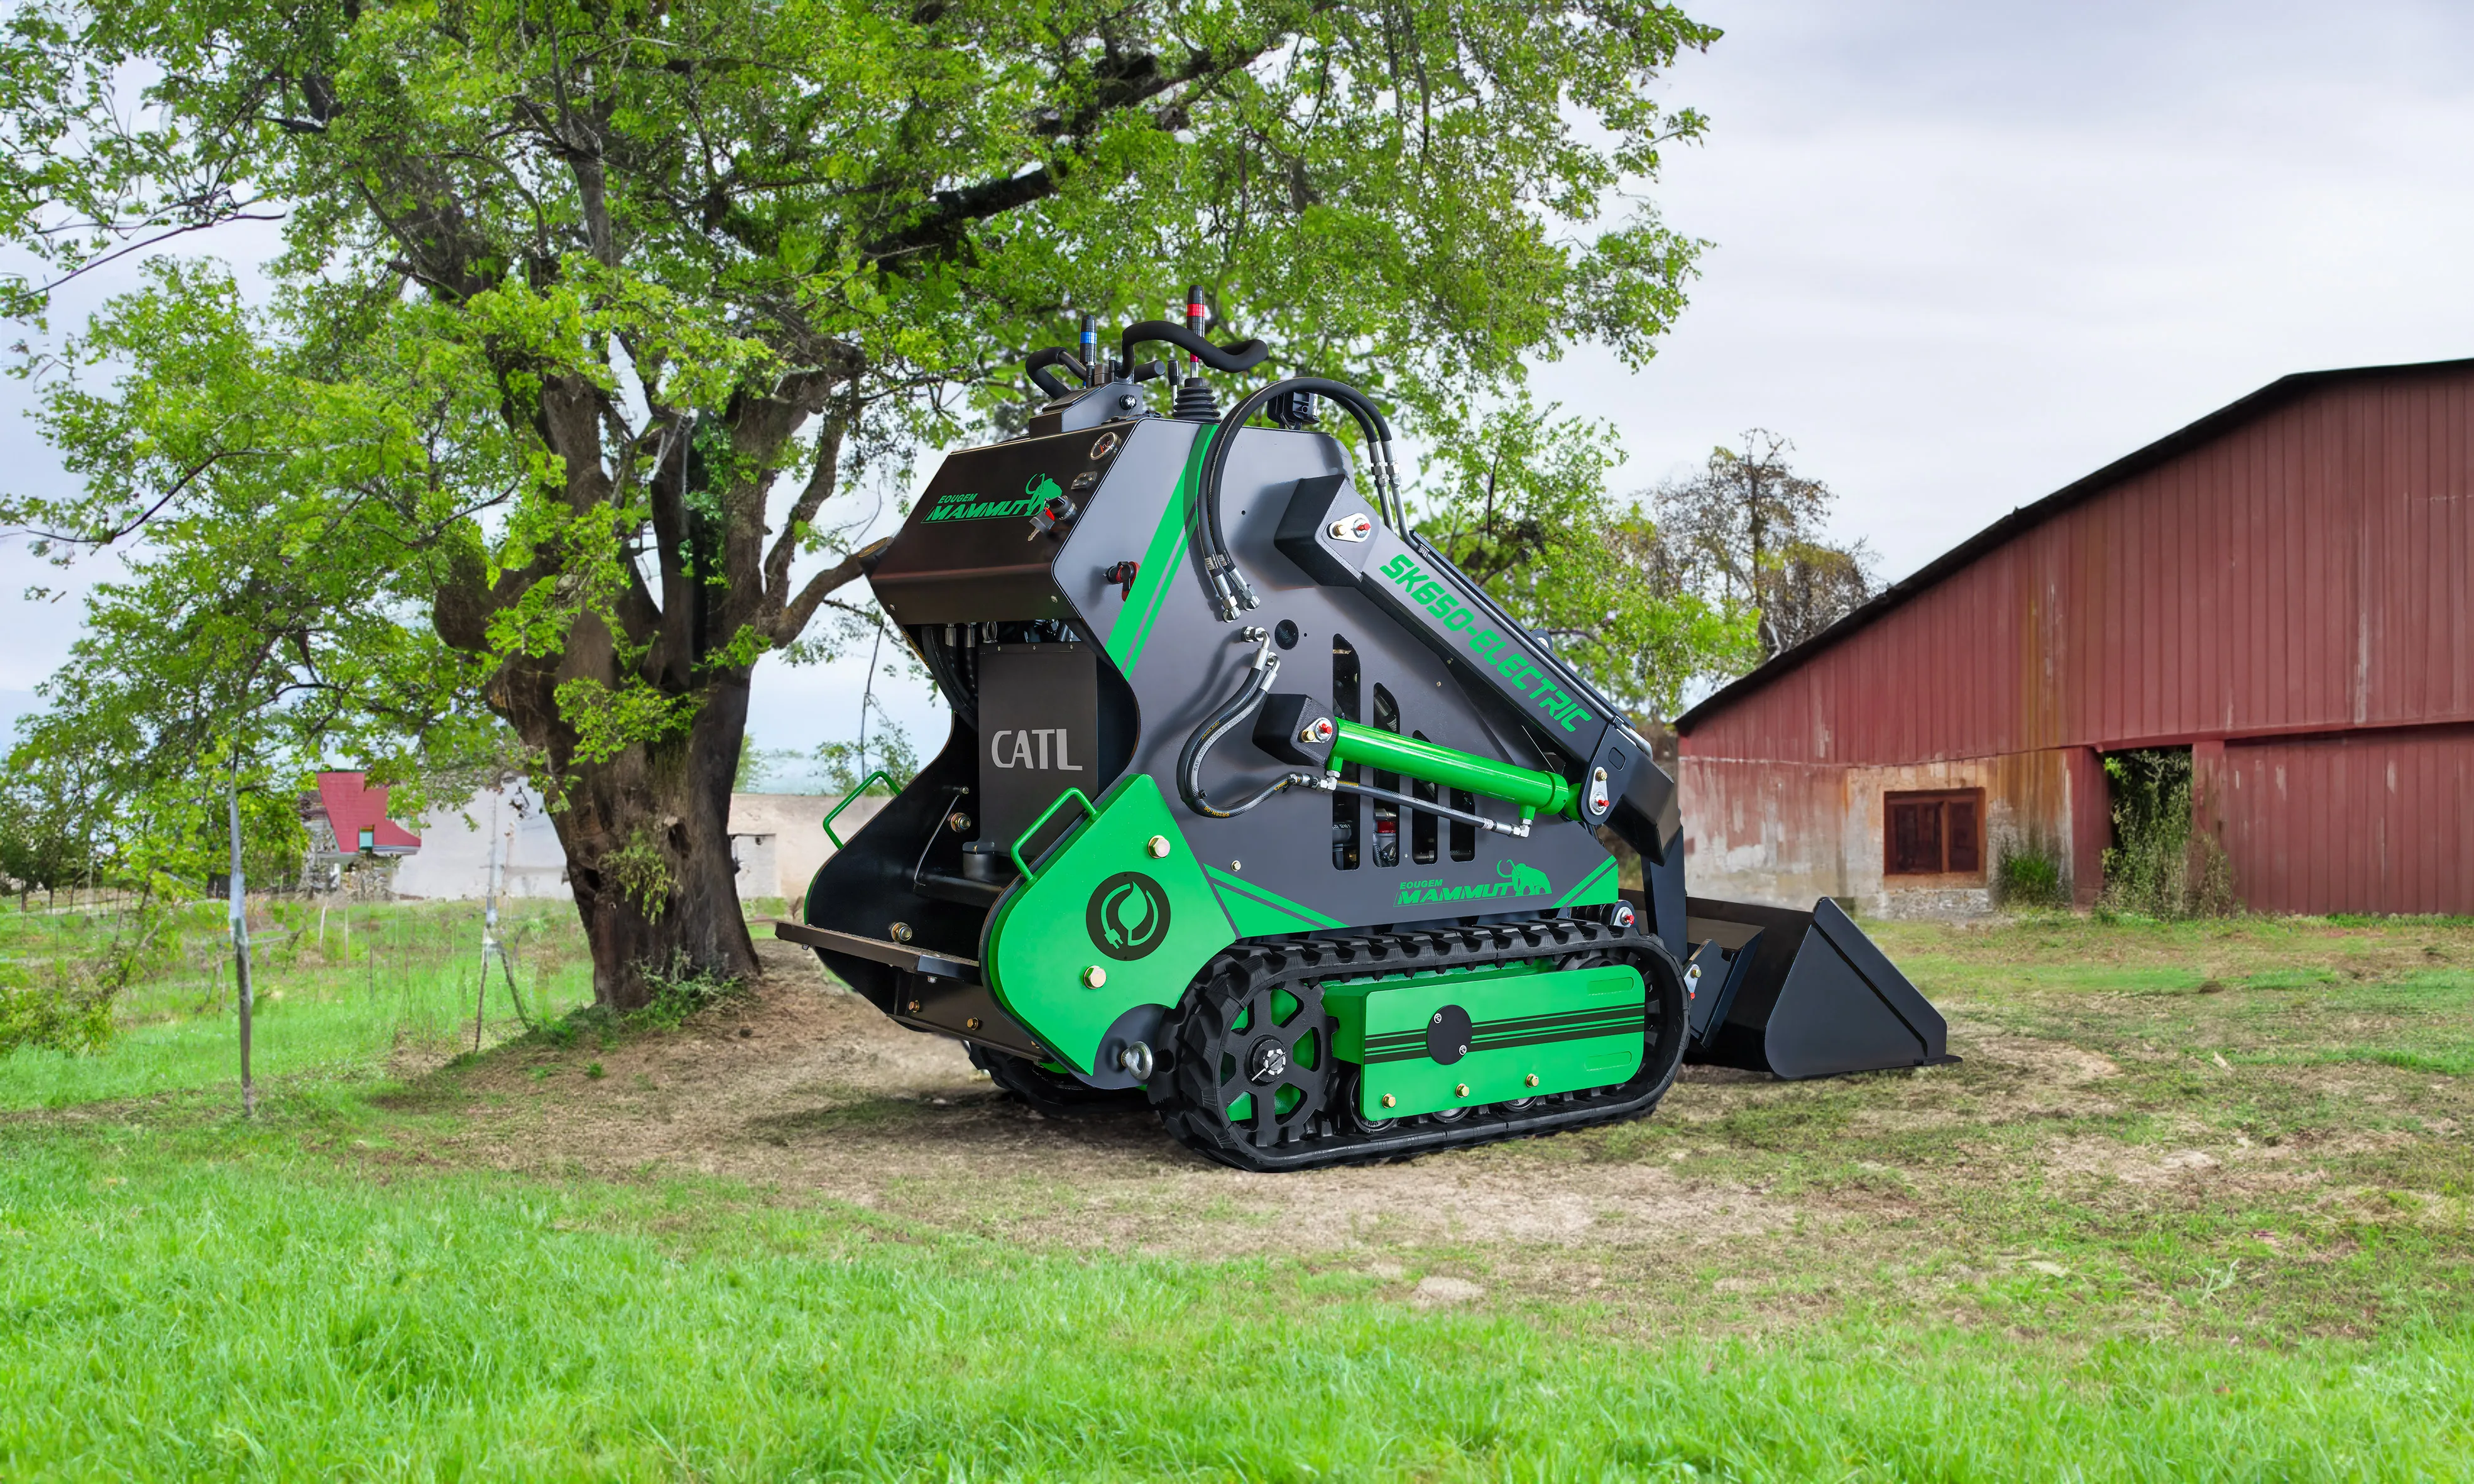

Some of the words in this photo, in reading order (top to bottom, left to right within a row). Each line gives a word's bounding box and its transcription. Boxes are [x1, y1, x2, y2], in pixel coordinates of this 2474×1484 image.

[938, 493, 978, 504] EOUGEM
[926, 499, 1031, 521] MAMMUT
[1379, 554, 1592, 733] SK650-ELECTRIC
[991, 729, 1083, 771] CATL
[1203, 806, 1230, 817] SR2SN-06
[1397, 882, 1513, 905] MAMMUT
[1399, 879, 1443, 890] EOUGEM
